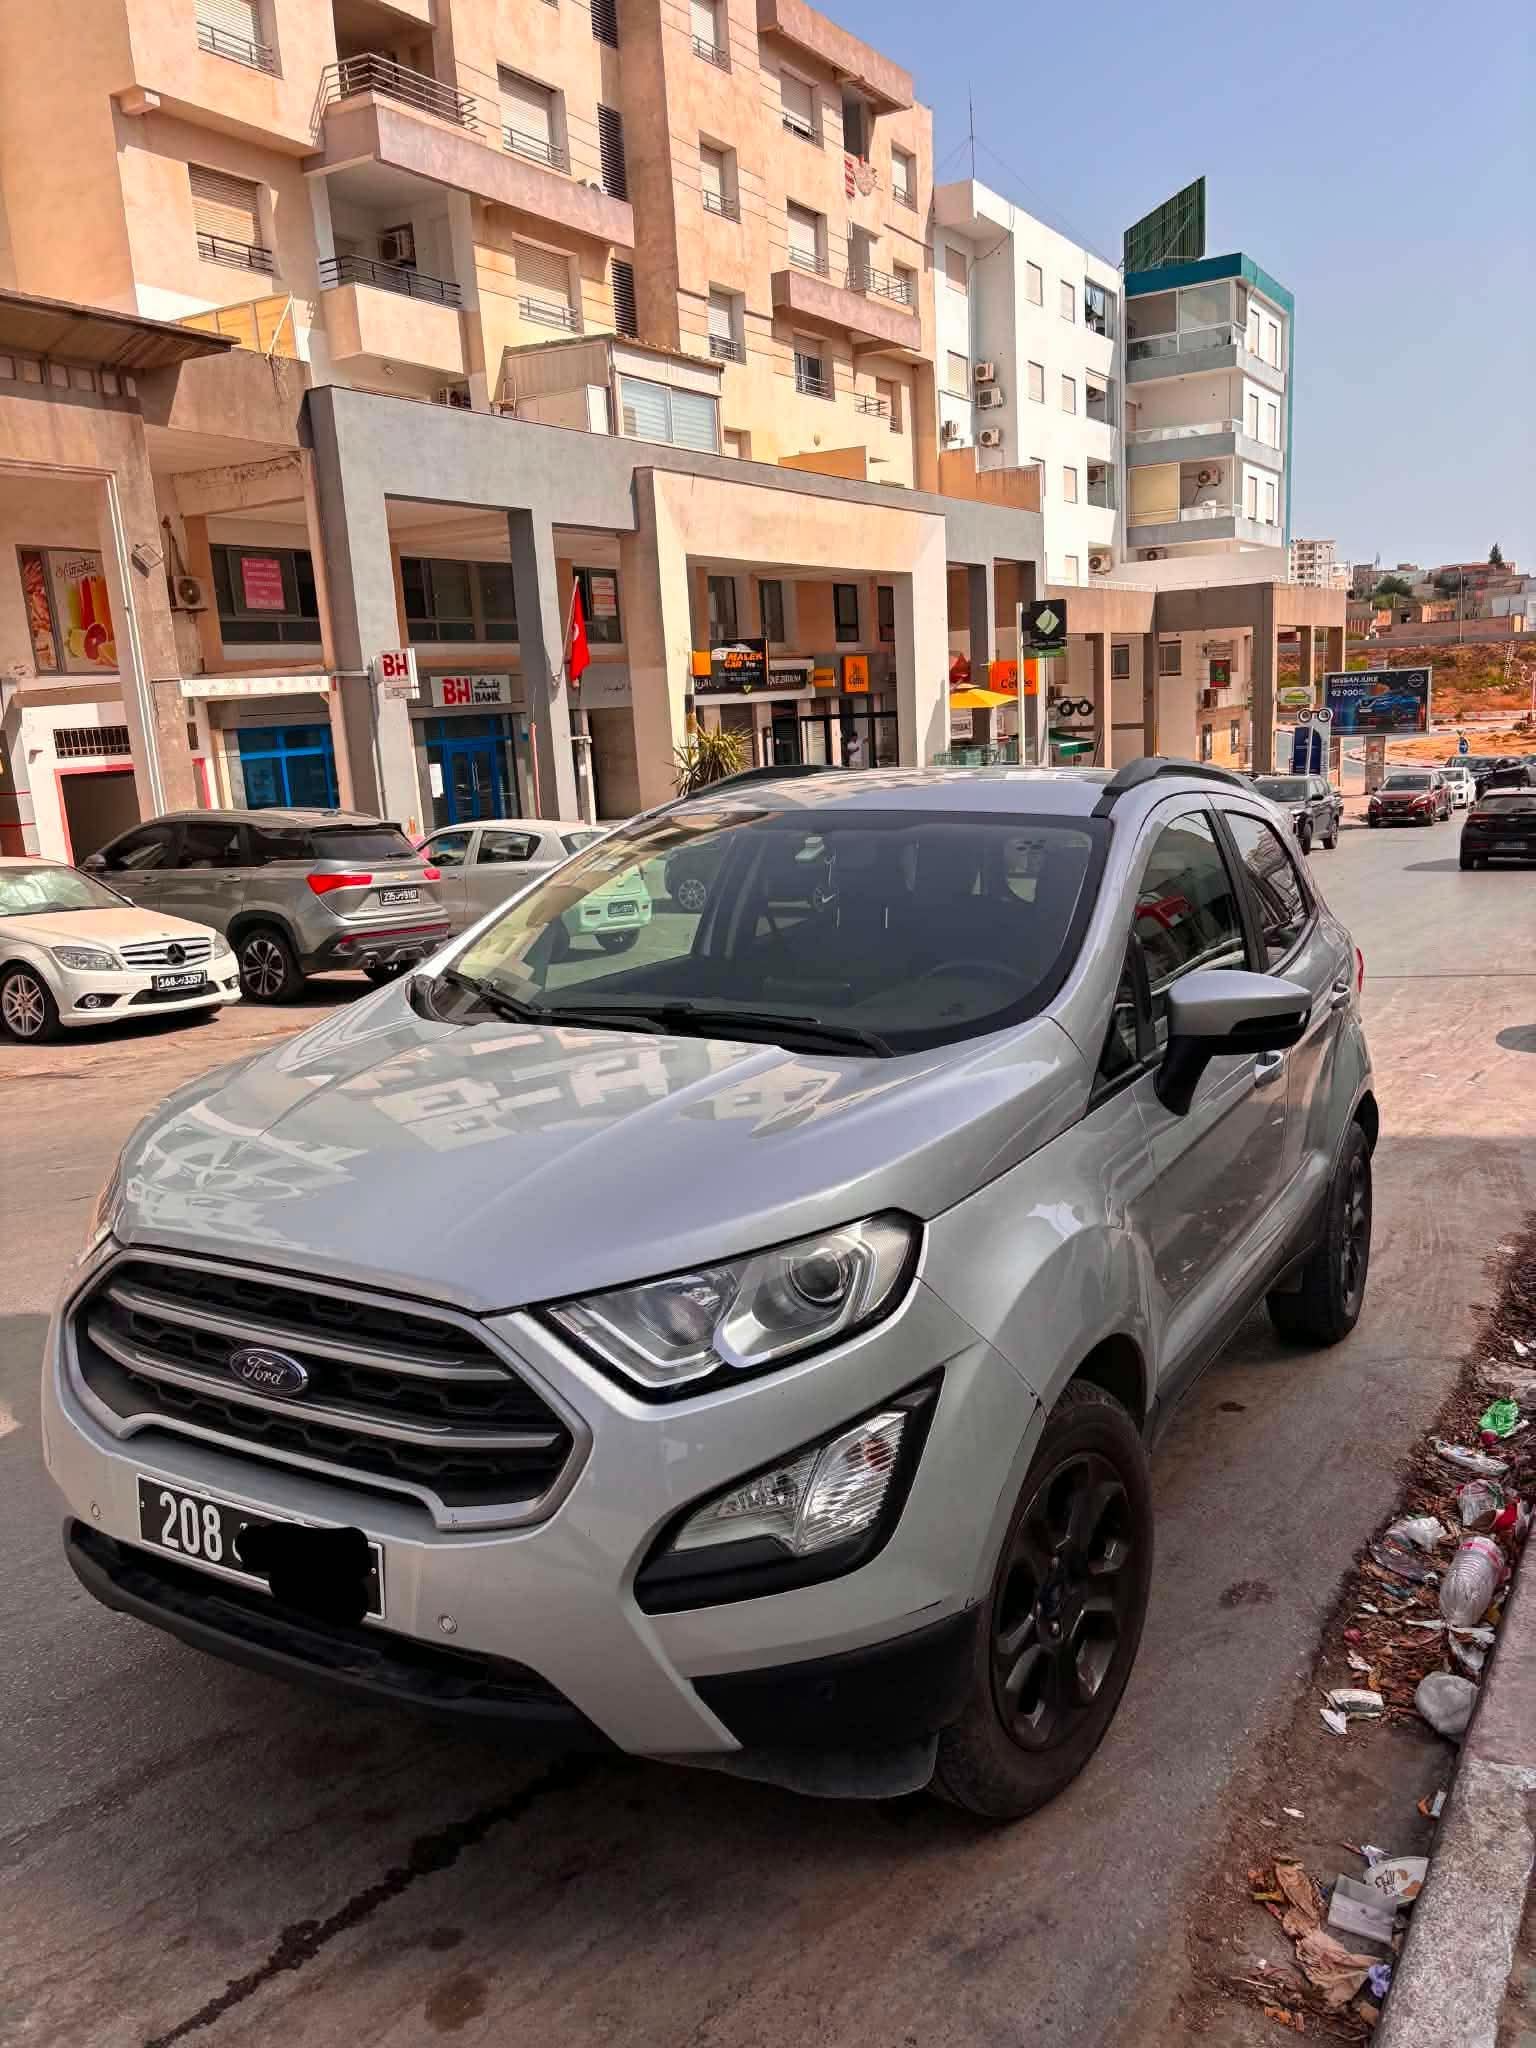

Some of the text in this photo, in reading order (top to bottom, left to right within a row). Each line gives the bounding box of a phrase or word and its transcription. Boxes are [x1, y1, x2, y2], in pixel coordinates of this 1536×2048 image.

[382, 653, 408, 677] BH
[441, 677, 471, 705] BH
[474, 691, 501, 703] BANK
[159, 977, 176, 988] 168
[241, 1354, 282, 1385] Ford
[159, 1490, 223, 1562] 208
